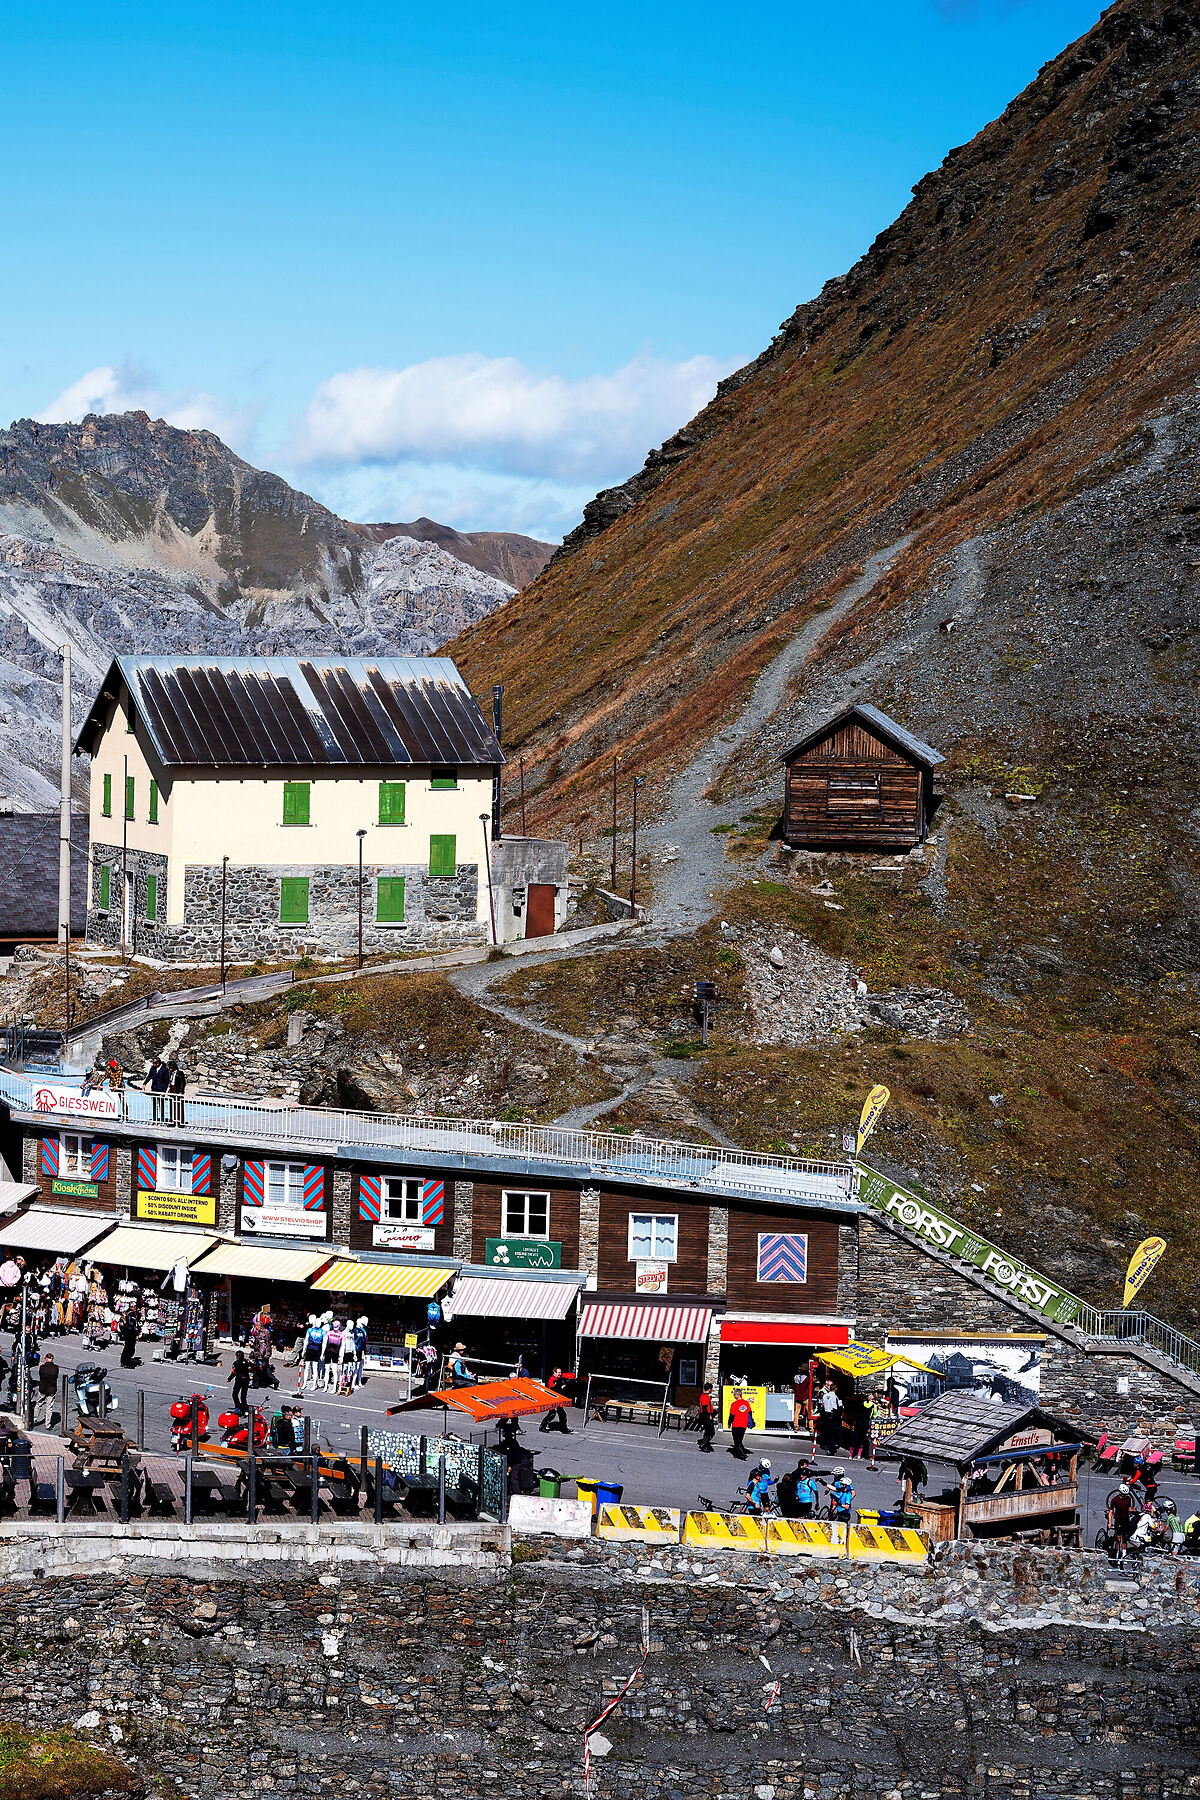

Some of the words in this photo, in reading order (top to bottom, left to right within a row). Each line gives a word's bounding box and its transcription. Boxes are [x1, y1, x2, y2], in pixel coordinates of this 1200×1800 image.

[59, 1096, 116, 1113] GIESSWEIN
[860, 1105, 878, 1134] Bruno's
[53, 1181, 76, 1194] Kiosk
[885, 1192, 965, 1249] FORST
[981, 1250, 1060, 1309] FORST
[1127, 1257, 1152, 1285] Bruno's
[979, 1341, 1004, 1349] Passo
[874, 1422, 902, 1430] Bruno's
